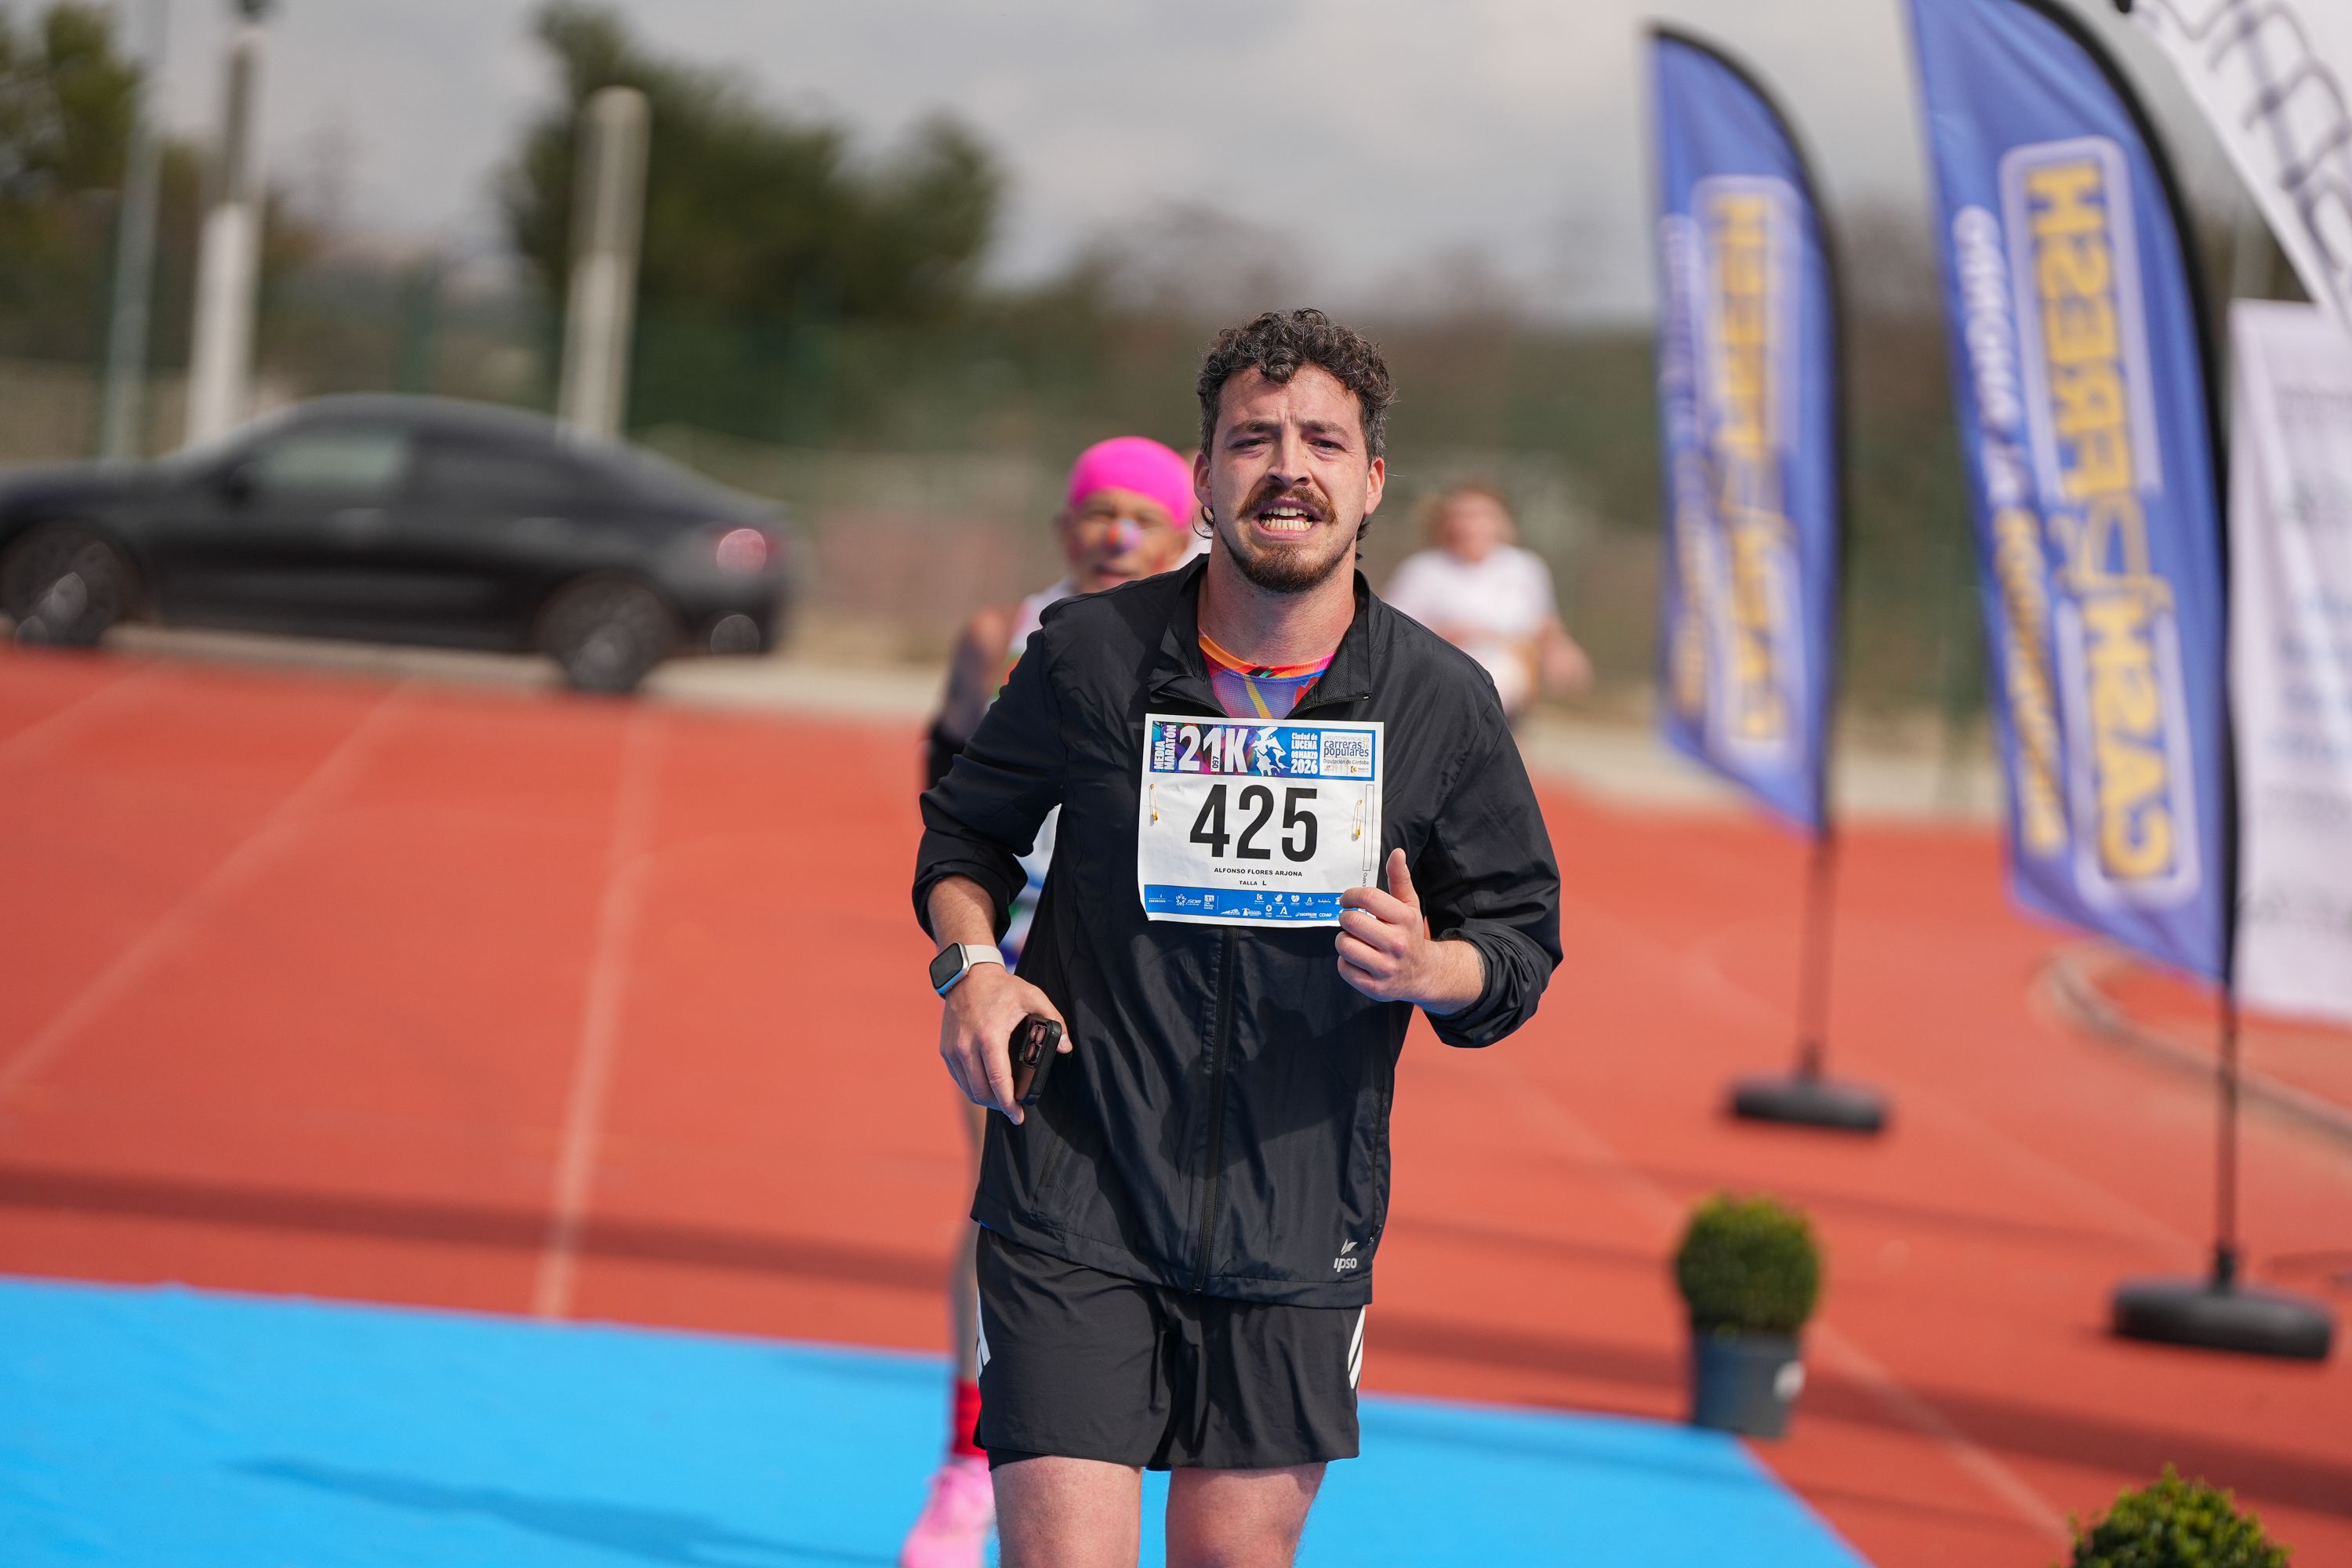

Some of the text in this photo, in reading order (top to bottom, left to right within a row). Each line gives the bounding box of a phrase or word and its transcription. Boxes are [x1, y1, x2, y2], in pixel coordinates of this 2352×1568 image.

[1291, 739, 1317, 750] LUCENA
[1292, 732, 1311, 741] Ciudad
[1163, 724, 1177, 770] MARATÓN
[1178, 725, 1249, 772] 21K
[1323, 746, 1369, 758] populares
[1324, 740, 1363, 750] carreras
[1154, 741, 1166, 770] MEDIA
[1290, 758, 1319, 774] 2026
[1190, 784, 1318, 862] 425
